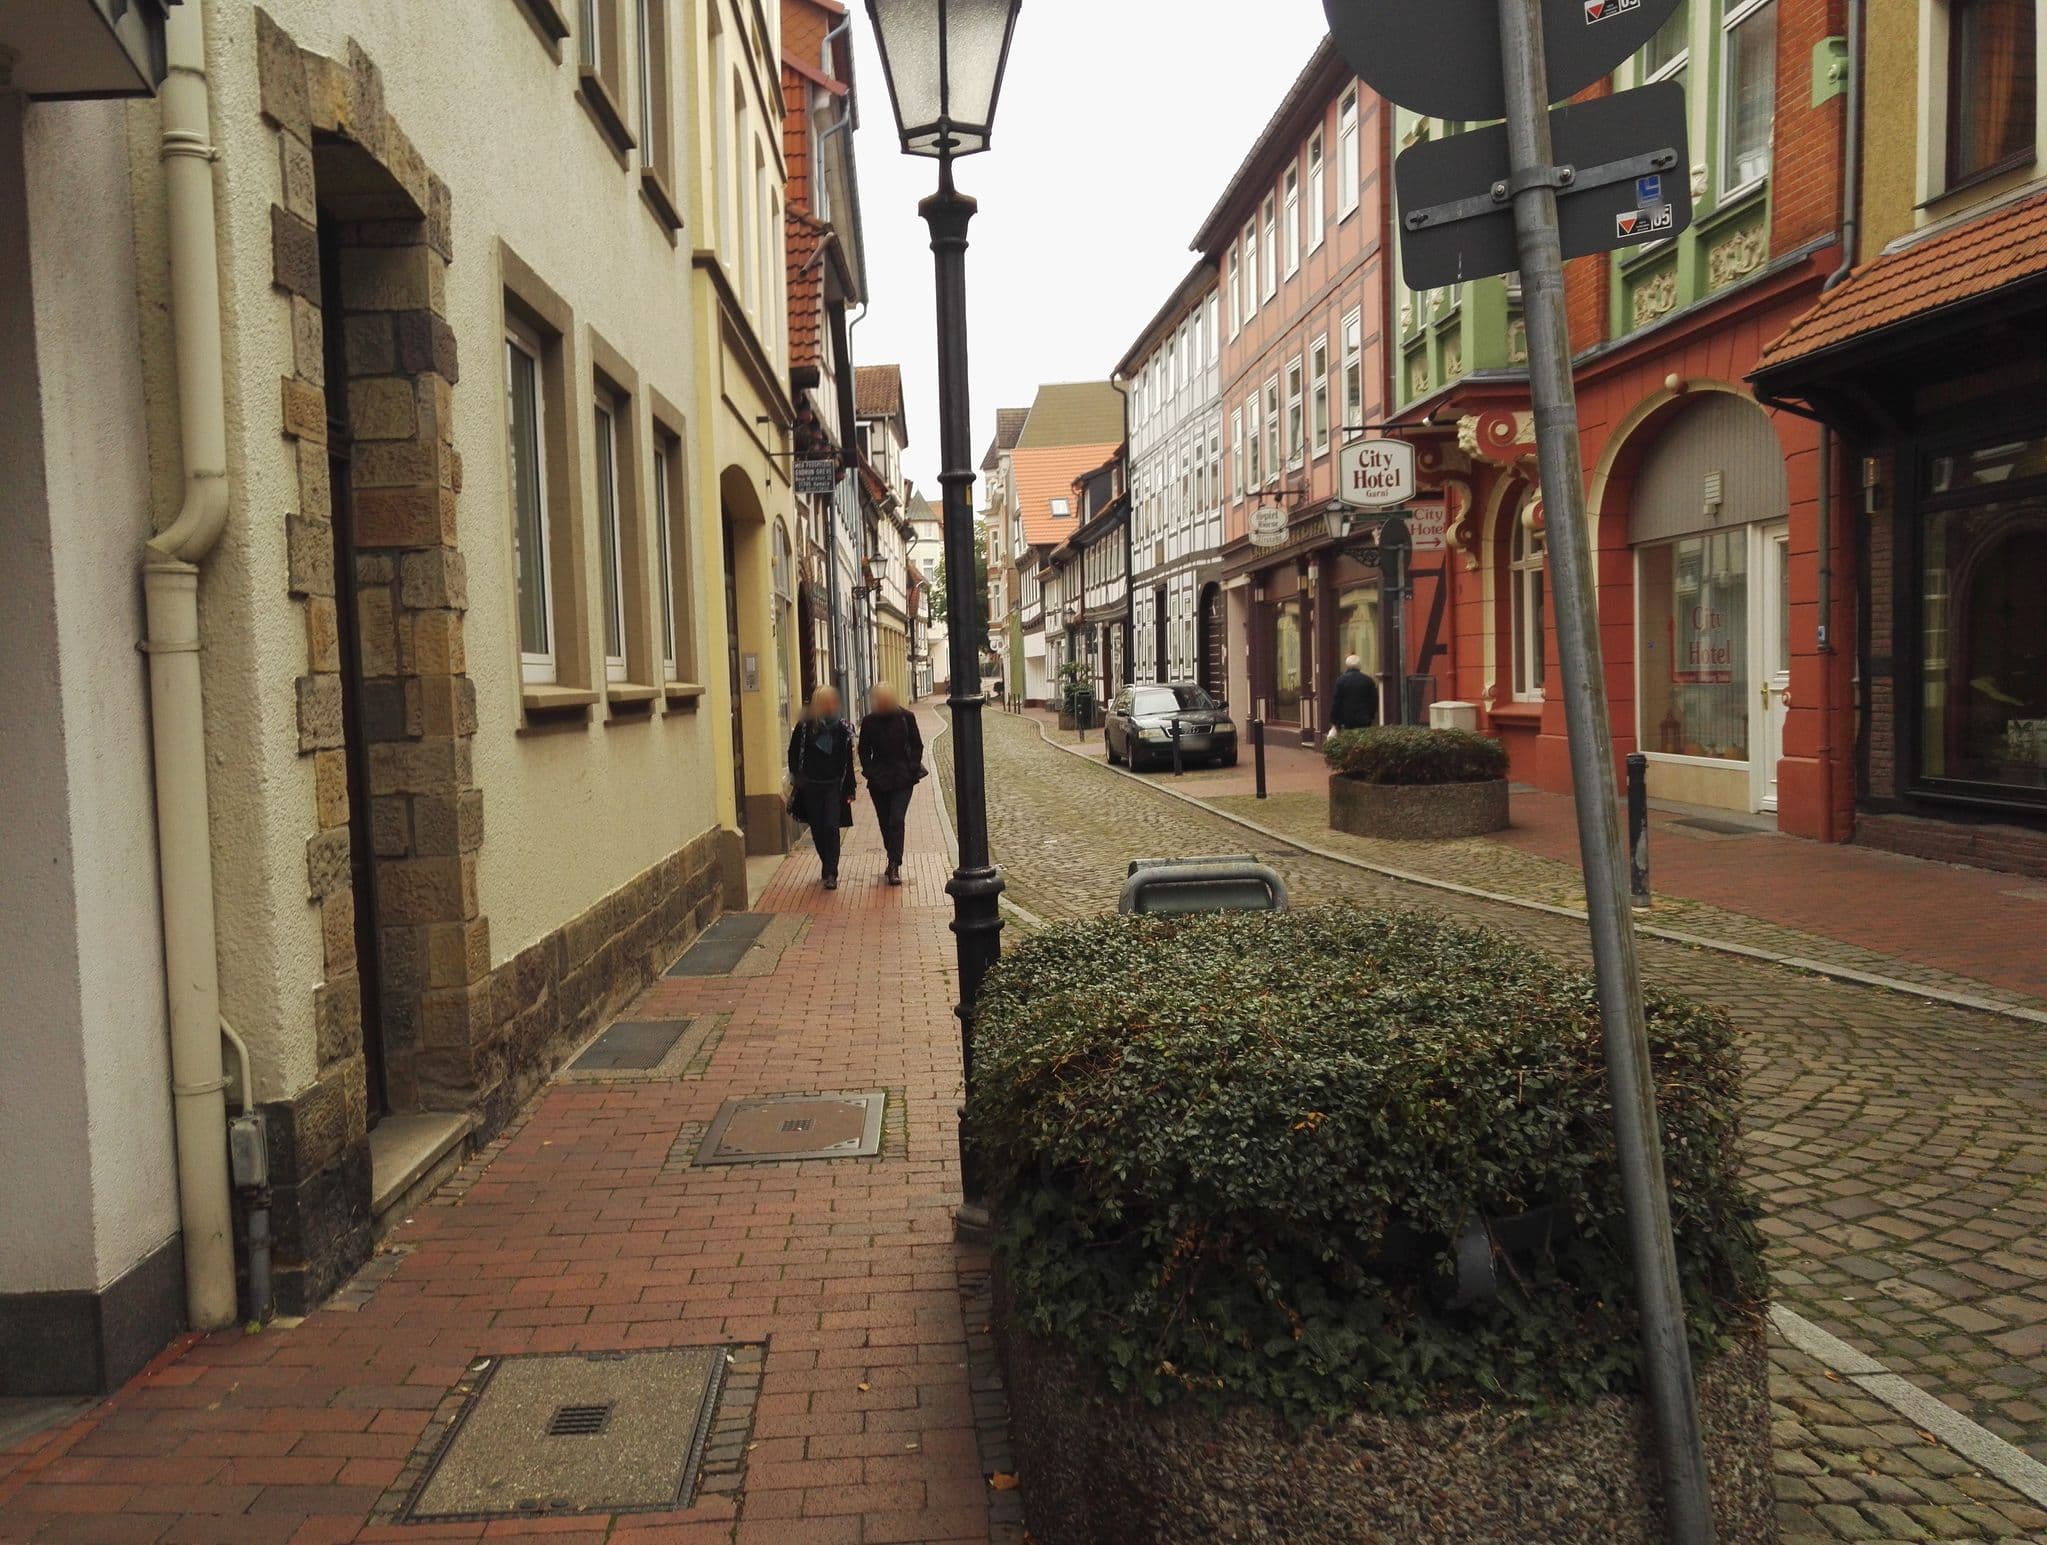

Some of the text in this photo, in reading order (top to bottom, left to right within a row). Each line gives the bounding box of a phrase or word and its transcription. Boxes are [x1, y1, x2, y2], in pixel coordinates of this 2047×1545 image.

[1359, 449, 1393, 470] City
[1353, 468, 1401, 489] Hotel
[1366, 489, 1389, 497] Garni
[1414, 508, 1443, 521] City
[1689, 640, 1732, 665] Hotel
